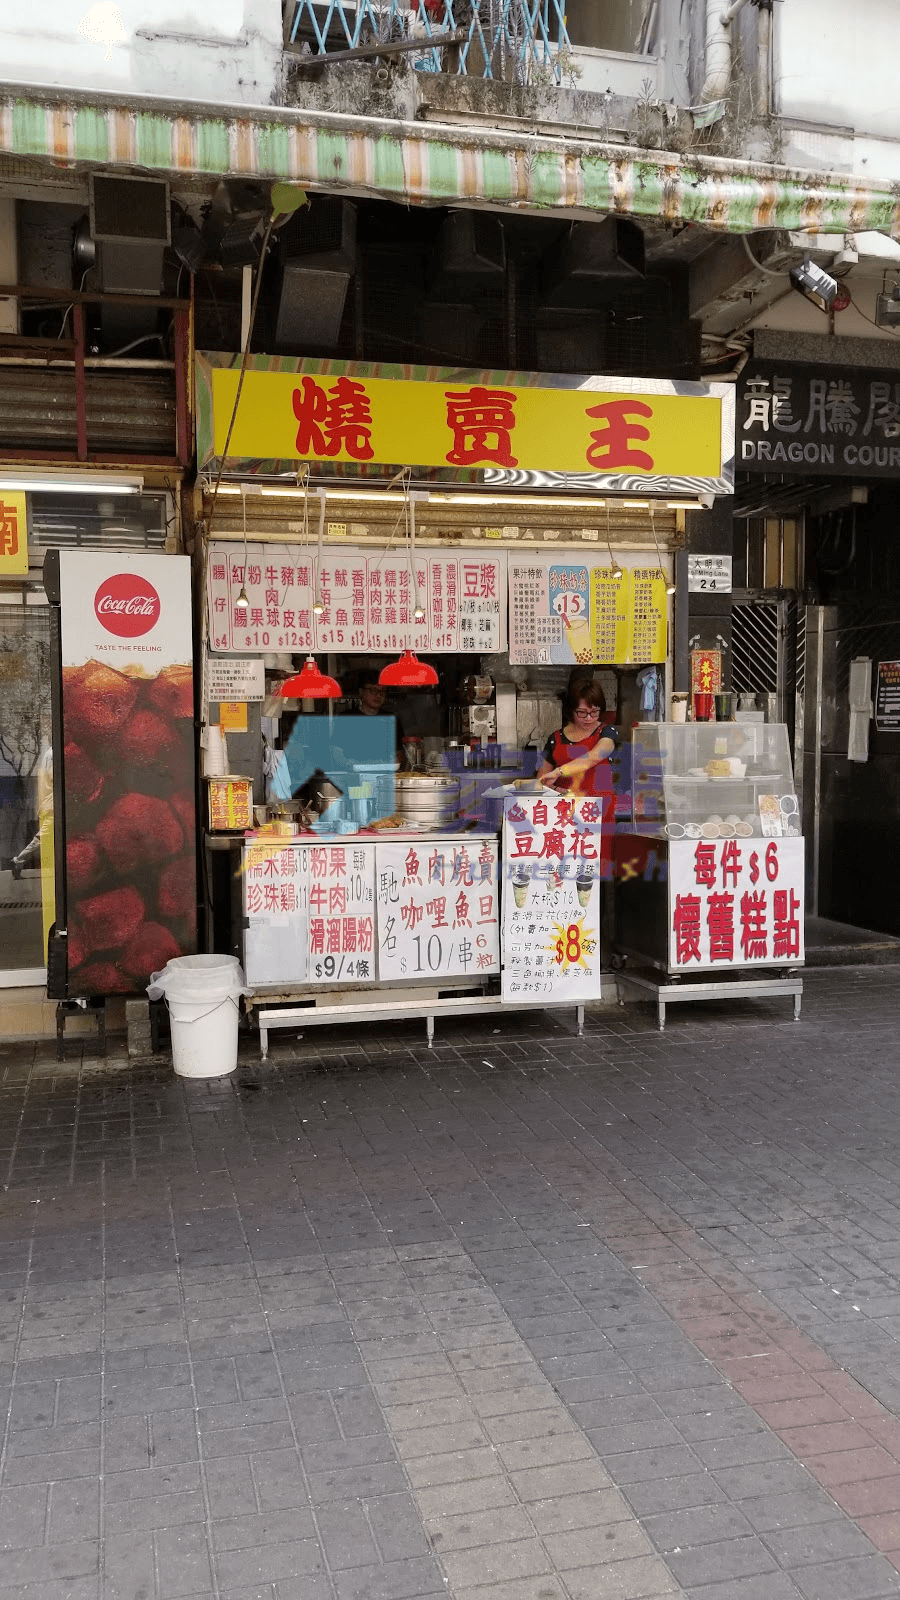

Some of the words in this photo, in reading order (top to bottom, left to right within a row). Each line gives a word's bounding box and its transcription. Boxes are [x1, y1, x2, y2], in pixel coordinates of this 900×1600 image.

[292, 376, 655, 471] 燒賣王
[741, 440, 835, 464] DRAGON
[212, 564, 227, 613] 腸仔
[463, 563, 496, 598] 豆漿
[513, 568, 543, 580] 果汁特飲
[550, 569, 588, 592] 珍珠奶茶
[700, 579, 717, 589] 24
[97, 595, 158, 616] Coca-Cola
[248, 565, 264, 628] 粉果
[264, 565, 280, 628] 牛肉球
[280, 565, 296, 629] 豬皮
[335, 569, 348, 626] 魷魚
[370, 569, 382, 624] 咸肉粽
[384, 569, 397, 625] 糯米雞
[432, 563, 443, 630] 香滑咖啡
[446, 563, 457, 630] 濃滑奶茶
[215, 634, 227, 648] $4
[245, 632, 270, 646] $10
[278, 632, 297, 646] $12
[299, 632, 312, 646] $8
[322, 630, 344, 643] $15
[351, 631, 365, 647] $12
[368, 635, 381, 648] $15
[383, 635, 397, 648] $18
[415, 635, 428, 648] $12
[435, 634, 452, 647] $15
[532, 798, 578, 828] 自製
[510, 828, 598, 860] 豆腐花
[295, 849, 308, 873] $18
[310, 847, 347, 878] 粉果
[401, 845, 495, 887] 魚肉燒賣
[694, 840, 779, 889] 每件$6
[309, 882, 347, 914] 牛肉
[400, 890, 497, 931] 咖哩魚旦
[310, 917, 373, 955] 滑溜腸粉
[673, 887, 800, 964] 懷舊糕點
[400, 934, 473, 973] $10/串
[476, 934, 496, 969] 6粒
[555, 924, 581, 965] $8
[315, 955, 370, 980] $9/4條
